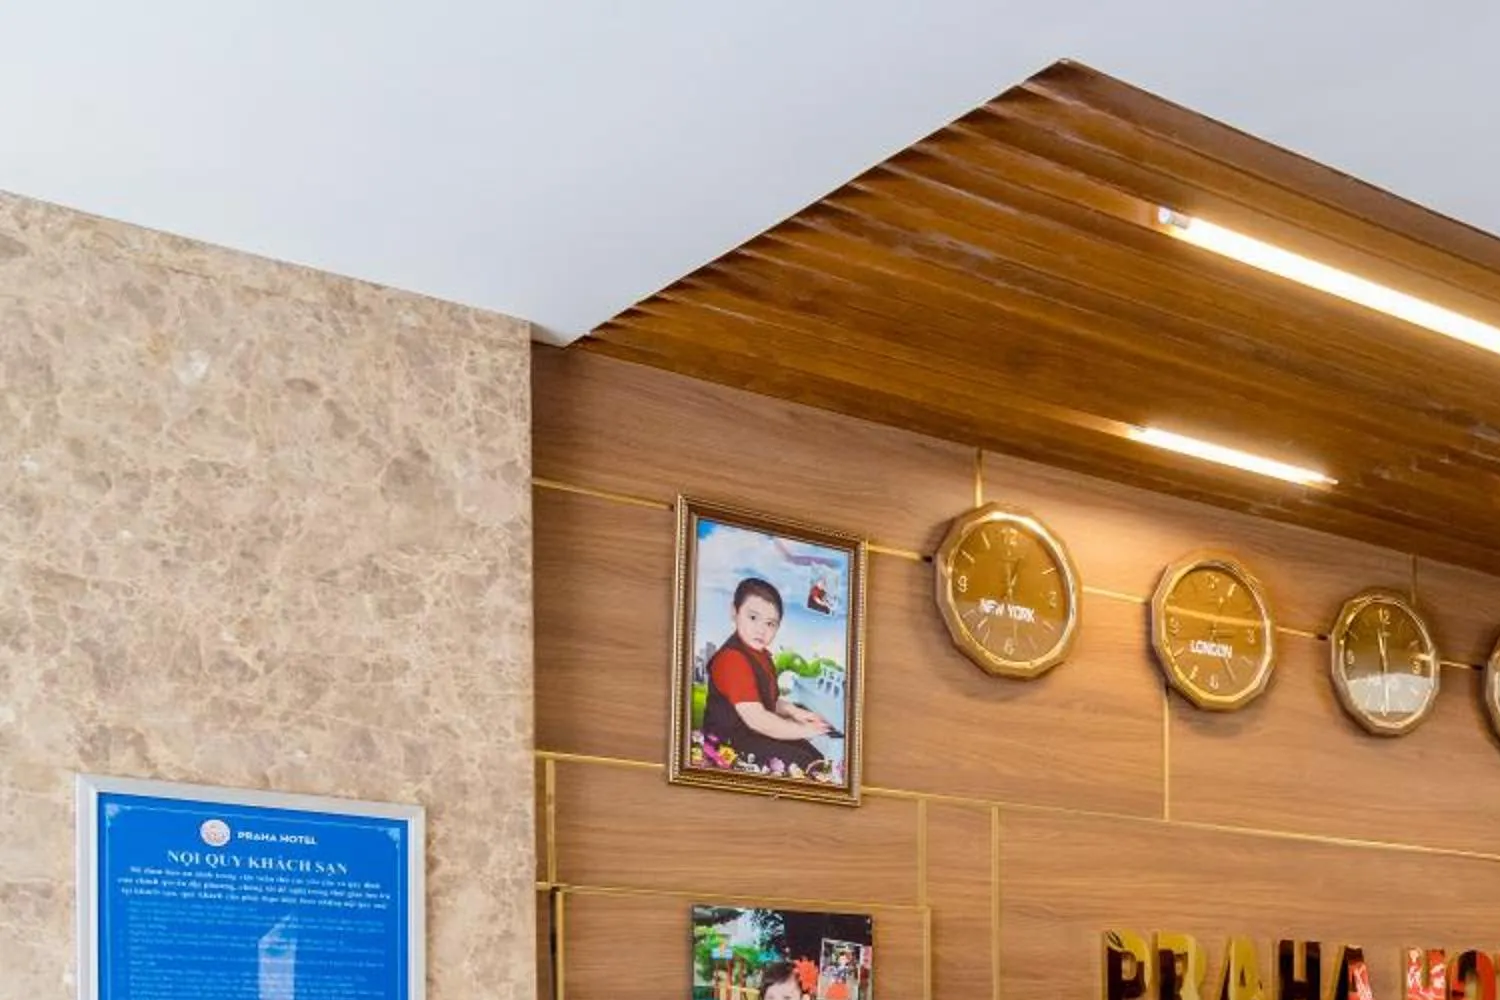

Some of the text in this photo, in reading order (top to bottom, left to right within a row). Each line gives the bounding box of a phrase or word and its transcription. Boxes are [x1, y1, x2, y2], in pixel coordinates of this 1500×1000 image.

[980, 598, 1036, 623] NEW YORK
[1189, 640, 1232, 659] LONDON
[237, 831, 318, 846] PRAHA HOTEL
